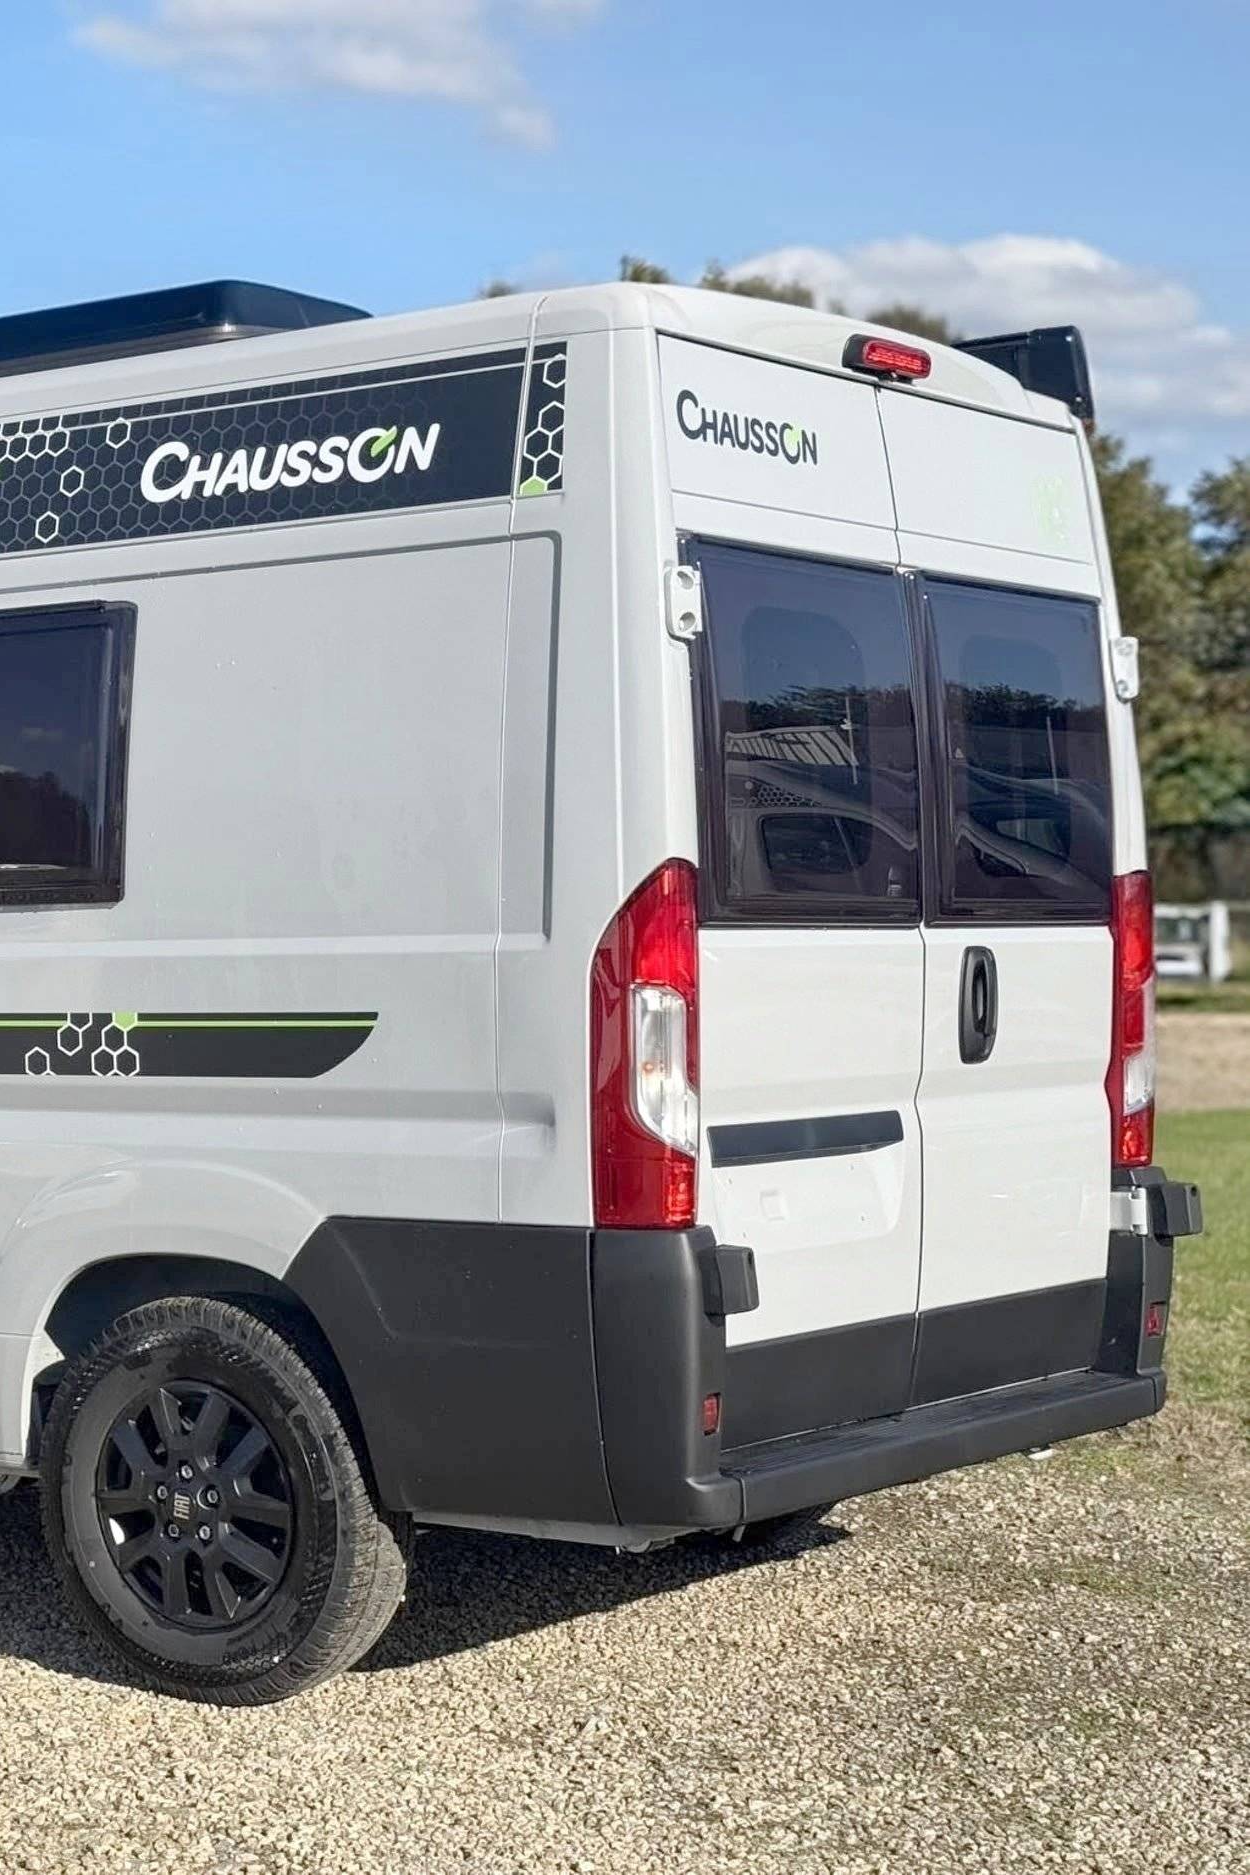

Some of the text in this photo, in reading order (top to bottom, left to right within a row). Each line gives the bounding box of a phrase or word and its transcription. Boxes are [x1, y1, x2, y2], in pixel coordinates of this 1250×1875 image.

[140, 423, 441, 502] CHAUSSON
[676, 389, 817, 465] CHAUSSON
[173, 1492, 190, 1519] FIAT
